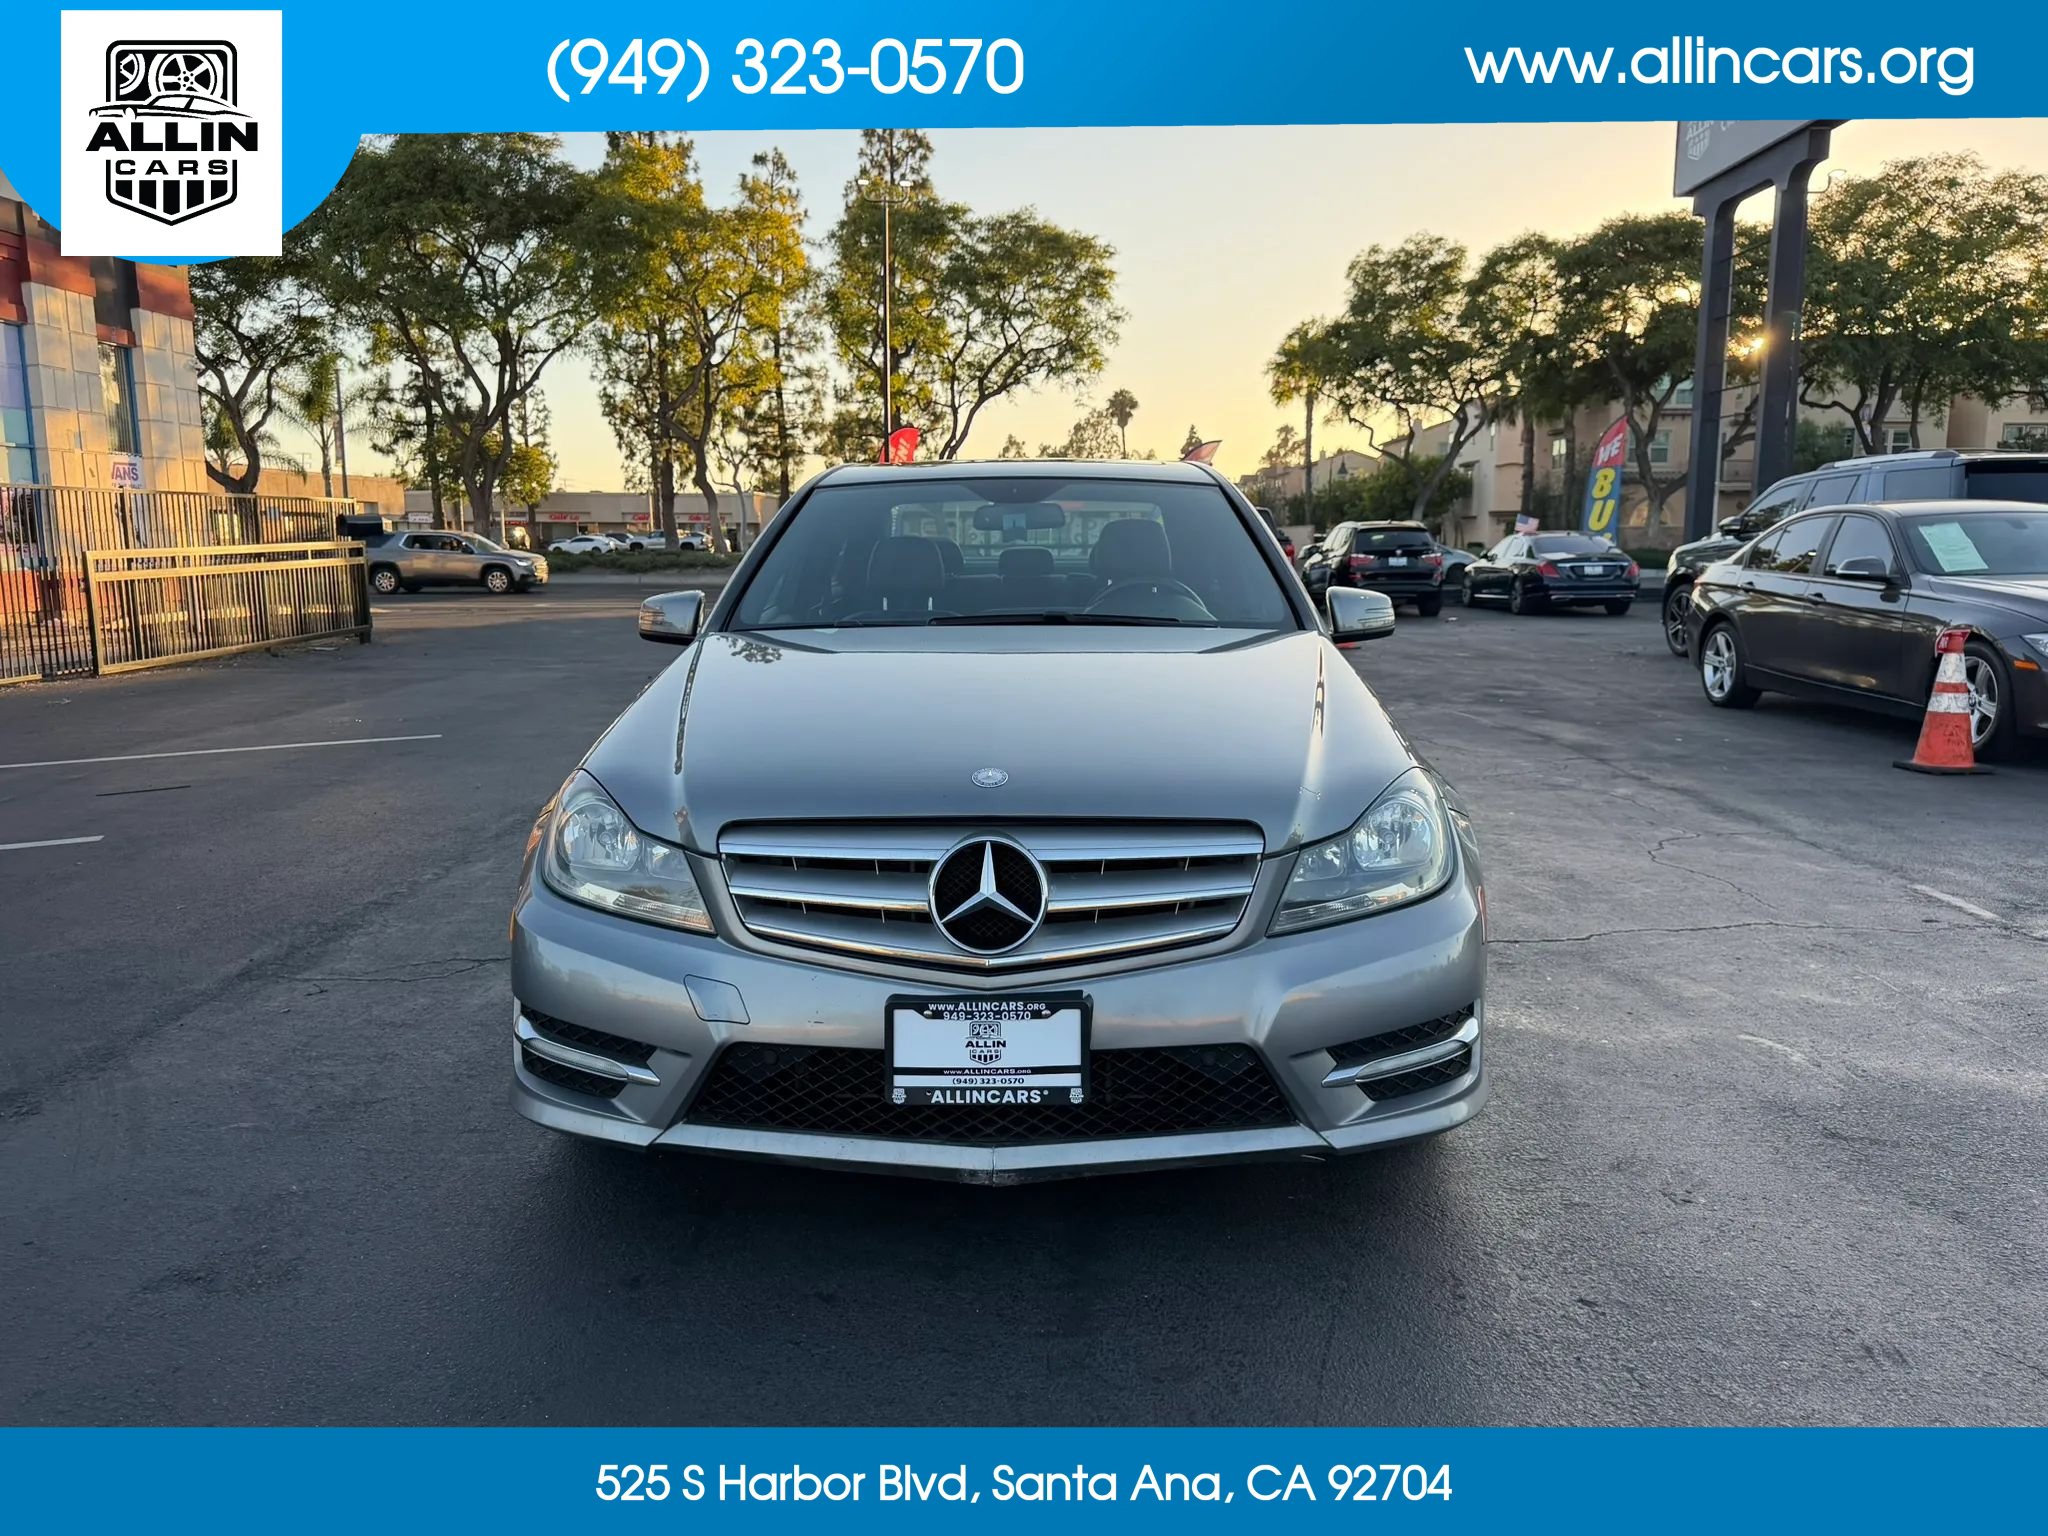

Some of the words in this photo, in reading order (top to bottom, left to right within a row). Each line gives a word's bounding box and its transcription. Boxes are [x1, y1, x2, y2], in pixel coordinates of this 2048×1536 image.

[1588, 468, 1616, 541] BU
[943, 1011, 1031, 1021] 949-323-0570
[965, 1040, 1007, 1049] ALLIN
[952, 1077, 978, 1085] (949)
[980, 1077, 1025, 1085] 323-0570
[930, 1089, 1042, 1104] ALLINCARS
